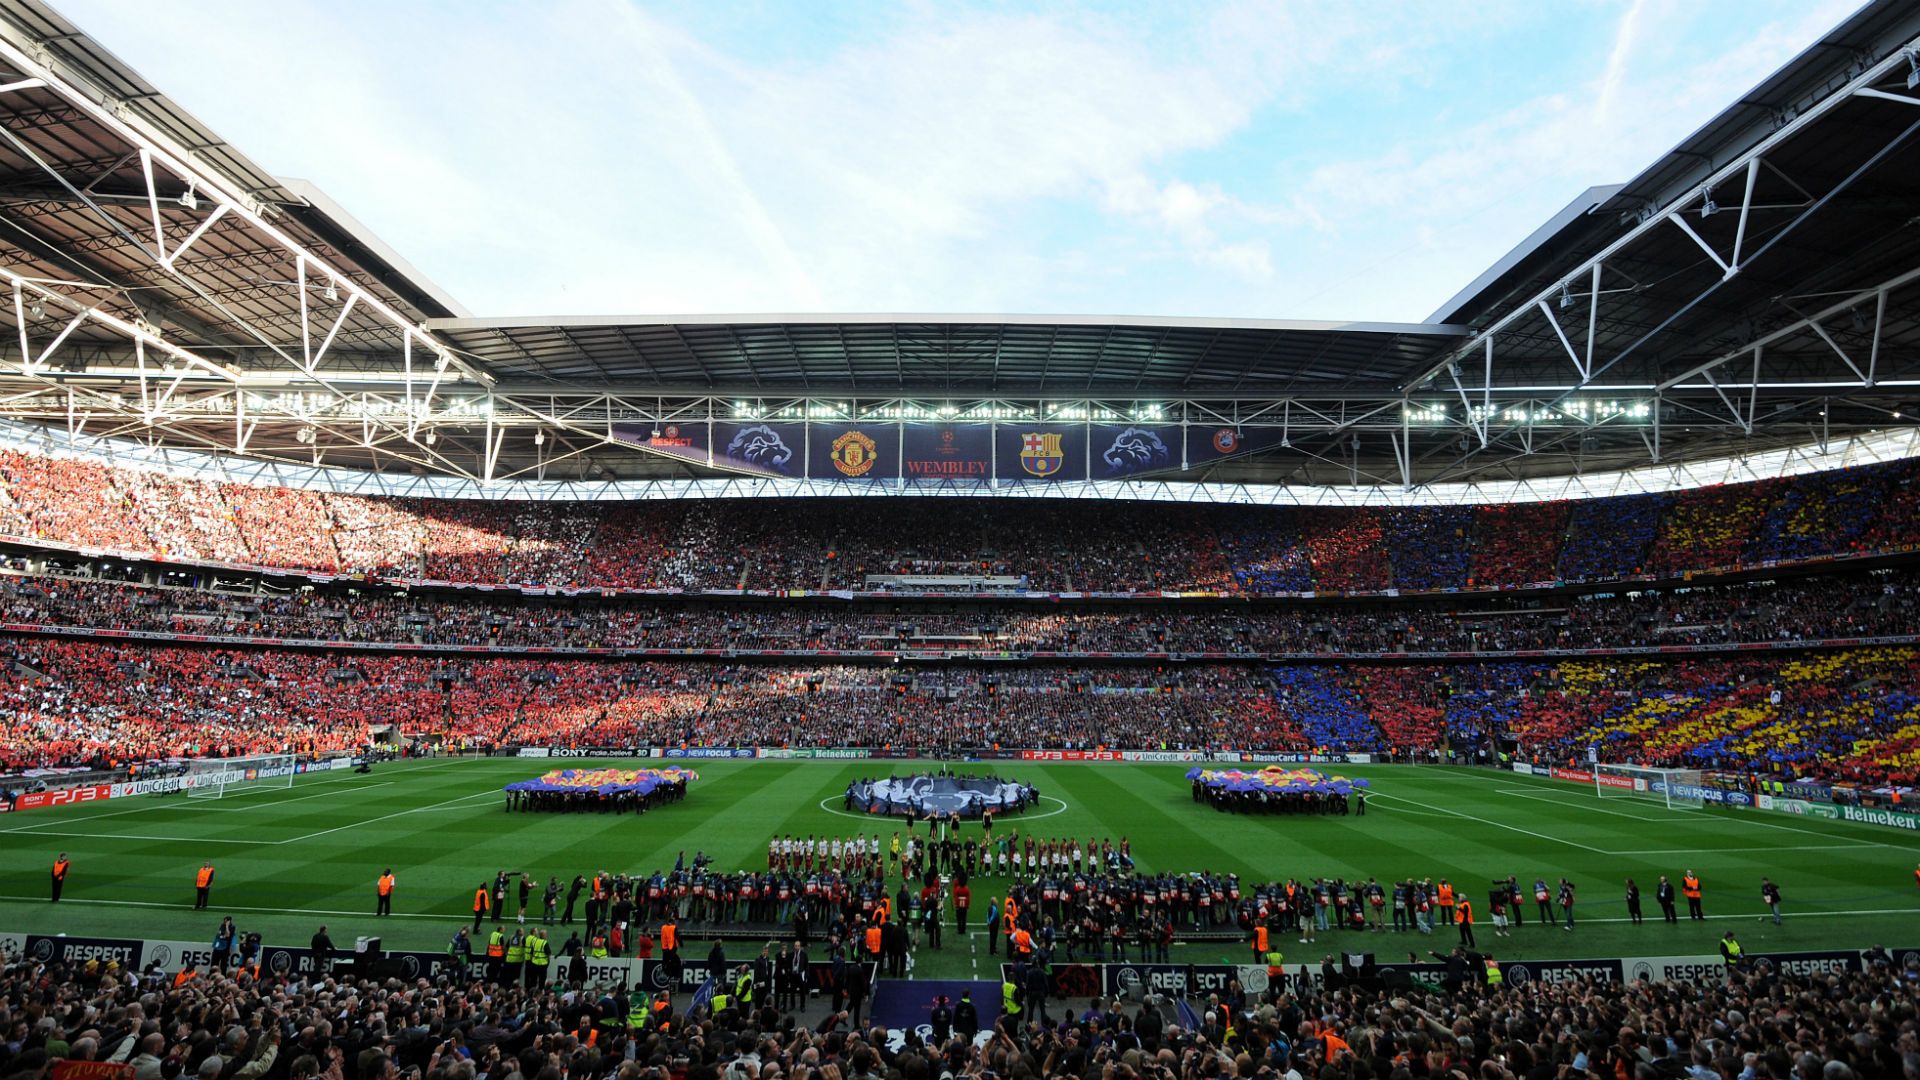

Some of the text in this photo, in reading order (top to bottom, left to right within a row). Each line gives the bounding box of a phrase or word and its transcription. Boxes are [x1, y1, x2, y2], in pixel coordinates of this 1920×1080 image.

[651, 438, 693, 448] RESPECT
[841, 463, 867, 474] UNITED
[907, 461, 988, 474] WEMBLEY
[551, 749, 589, 757] SONY
[815, 750, 856, 758] Heineken
[1033, 751, 1062, 760] PS3
[1084, 751, 1113, 760] PS3
[1142, 753, 1178, 761] UniCredit
[1253, 753, 1296, 761] MasterCard
[1310, 754, 1341, 762] Maesro
[306, 761, 330, 772] Maestro
[136, 779, 180, 793] UniCredit
[52, 787, 97, 804] PS3
[1673, 785, 1692, 796] NEW
[1692, 788, 1722, 801] FOCUS
[1844, 806, 1916, 829] Heineken
[63, 944, 133, 962] RESPECT
[557, 965, 631, 981] RPECT
[1664, 965, 1729, 980] RESPEC
[1151, 972, 1227, 990] RESECT
